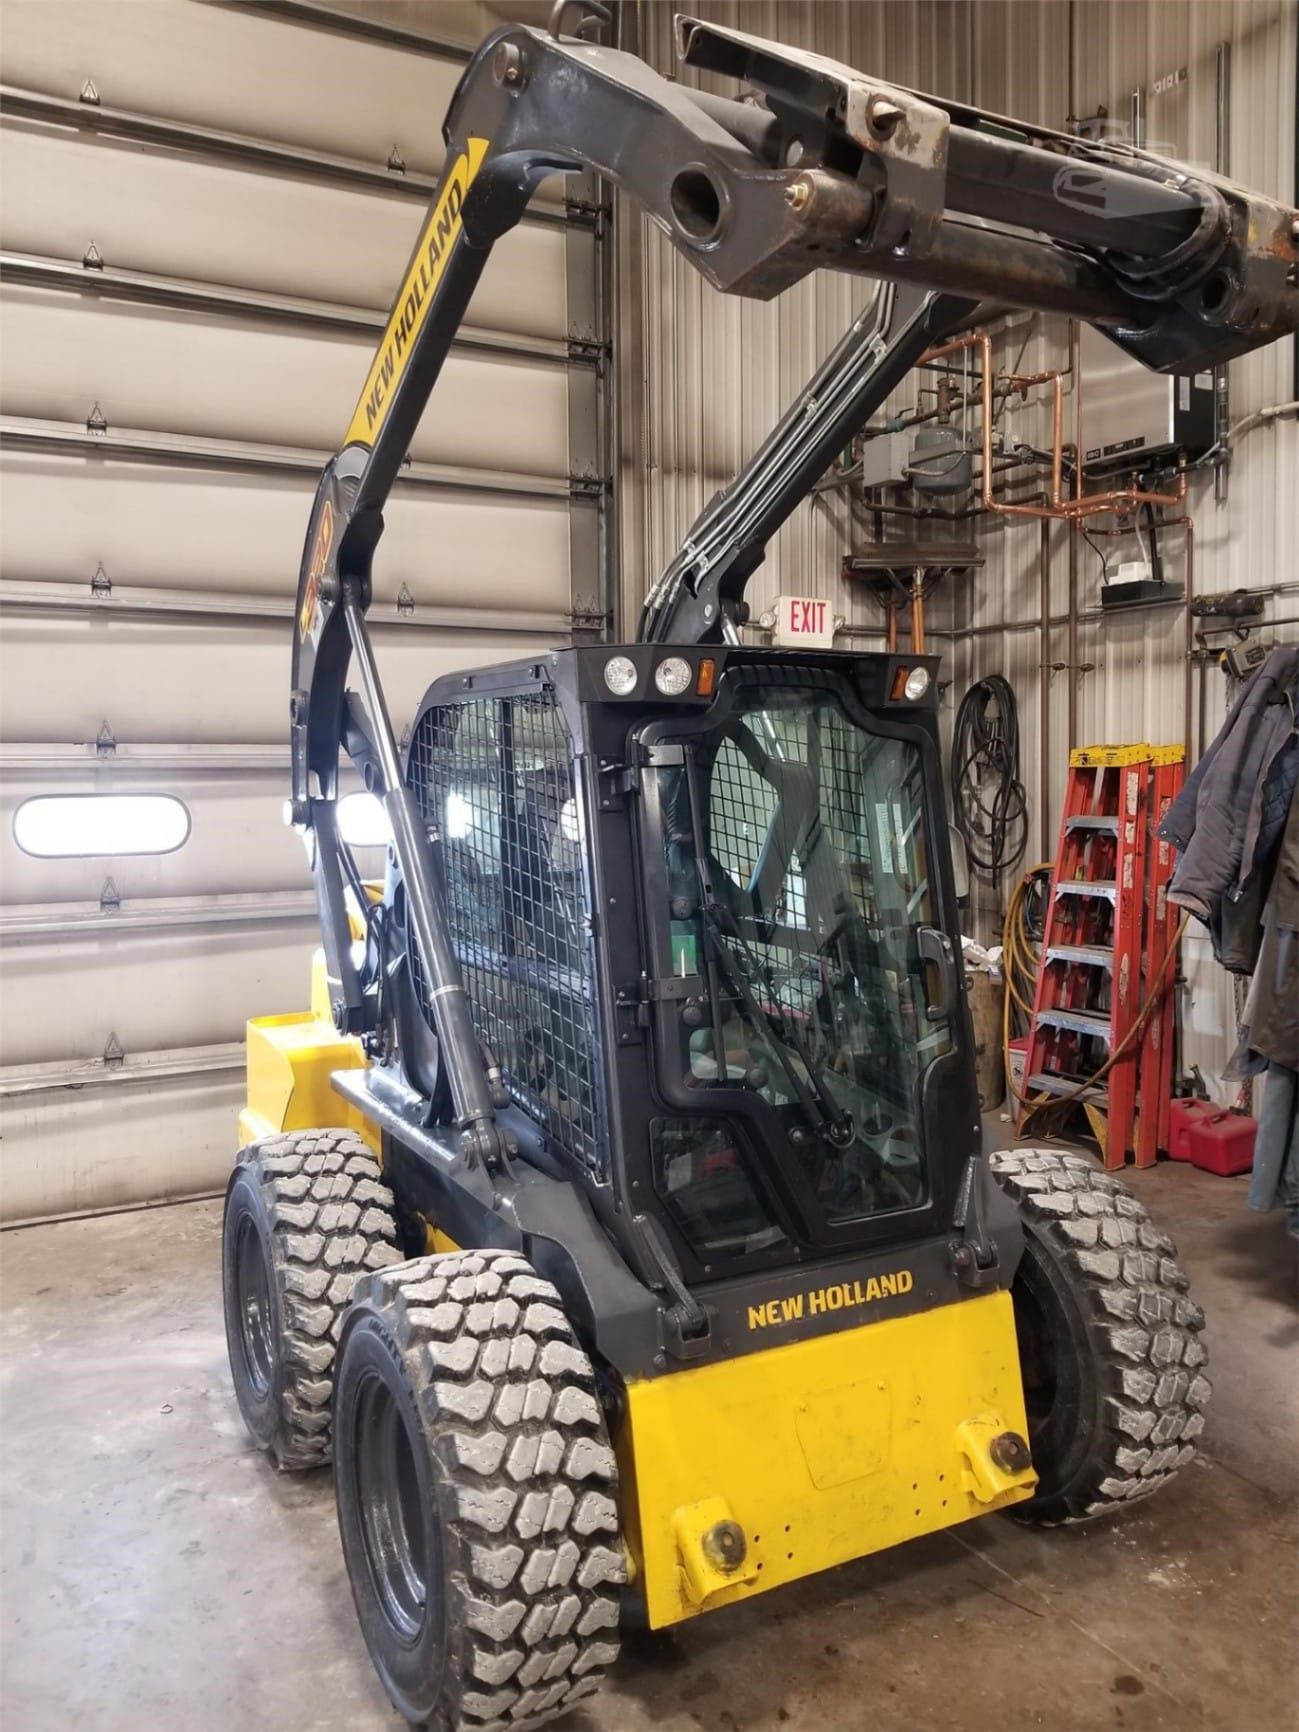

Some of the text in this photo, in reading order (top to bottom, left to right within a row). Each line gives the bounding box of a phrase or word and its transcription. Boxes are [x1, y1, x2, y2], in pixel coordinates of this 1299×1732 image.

[365, 178, 462, 430] NEW HOLLAND
[790, 600, 826, 634] EXIT
[748, 1270, 914, 1330] NEW HOLLAND
